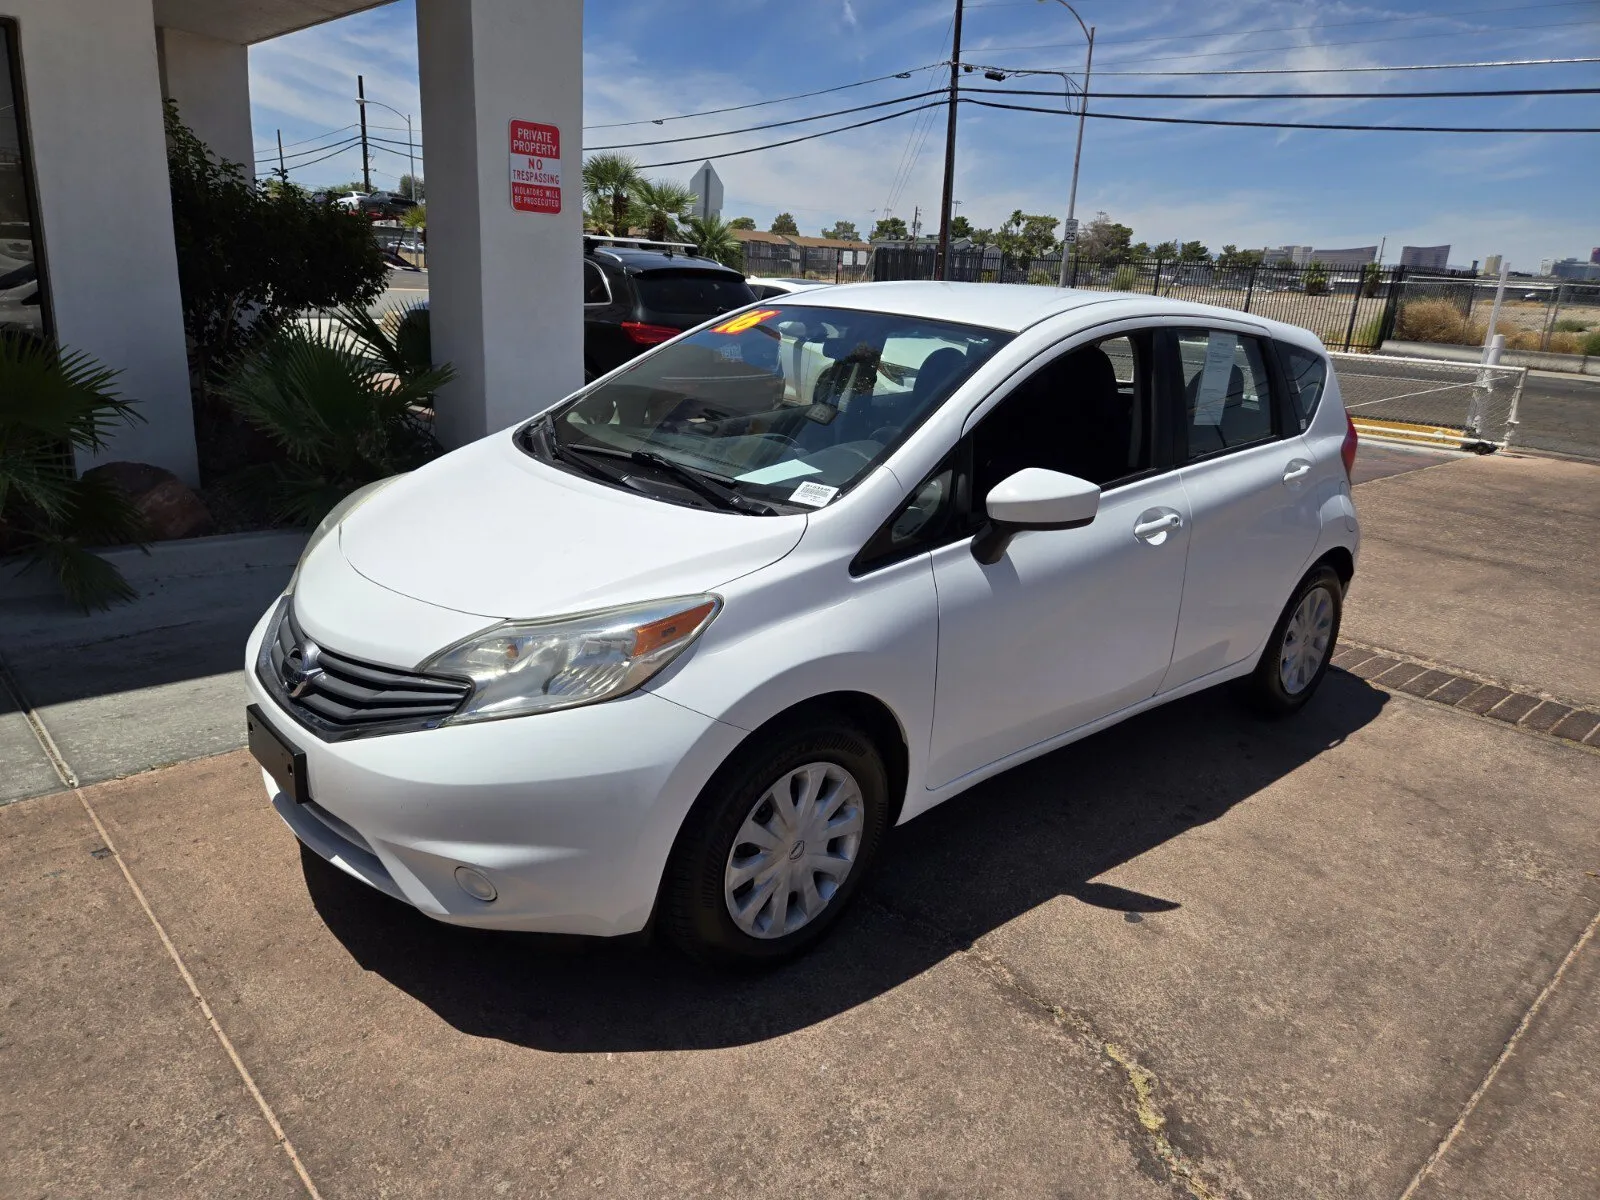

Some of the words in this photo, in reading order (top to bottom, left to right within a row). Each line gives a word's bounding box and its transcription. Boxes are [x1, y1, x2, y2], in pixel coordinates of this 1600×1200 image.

[517, 128, 552, 143] PRIVATE
[513, 139, 557, 155] PROPERTY
[528, 158, 543, 170] NO
[513, 169, 560, 185] TRESPASSING
[514, 186, 544, 198] VIOLATORS
[545, 190, 559, 199] WILL
[514, 195, 522, 204] BE
[523, 196, 560, 207] PROSECUTED
[1066, 232, 1076, 242] 25
